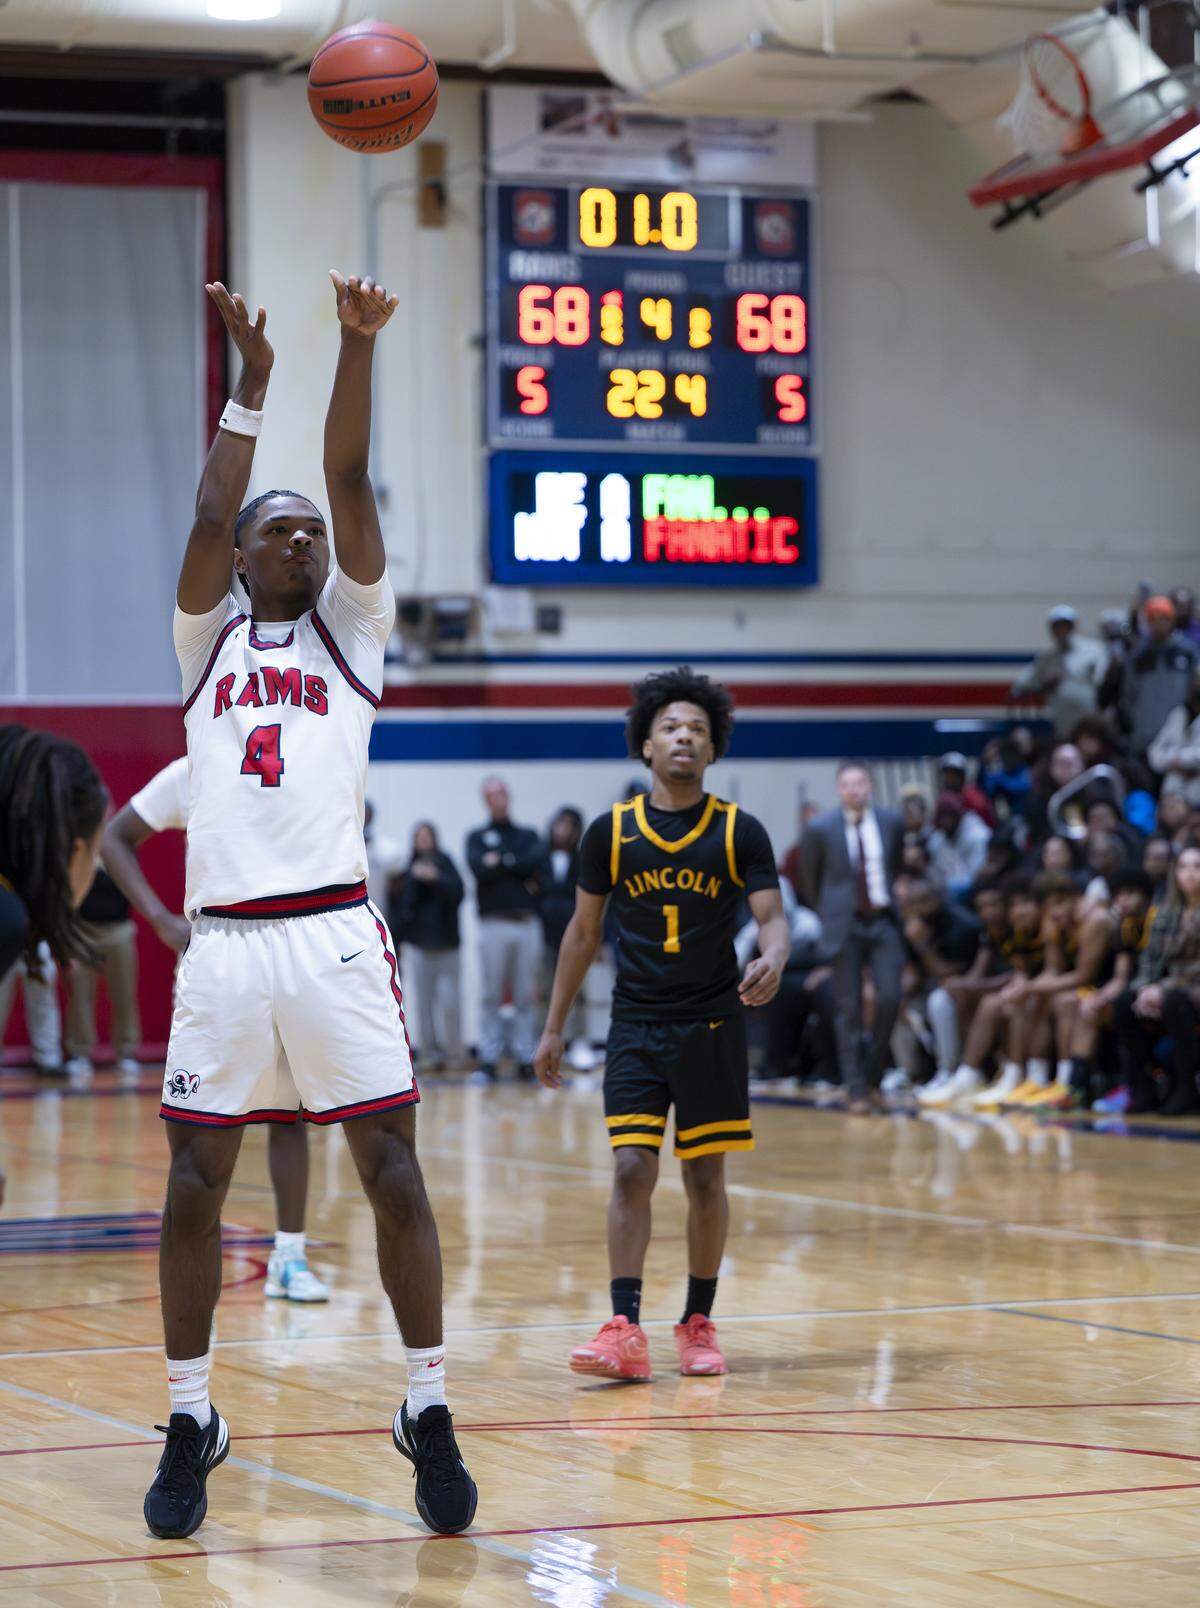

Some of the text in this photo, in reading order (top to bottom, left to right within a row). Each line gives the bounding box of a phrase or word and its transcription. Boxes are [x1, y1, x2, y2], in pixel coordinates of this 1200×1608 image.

[518, 285, 590, 346] 68
[640, 298, 672, 341] 4
[737, 293, 806, 352] 68
[607, 369, 708, 418] 22 4
[213, 666, 328, 719] RAMS
[240, 723, 285, 787] 4
[624, 867, 722, 899] LINCOLN
[662, 905, 681, 953] 1
